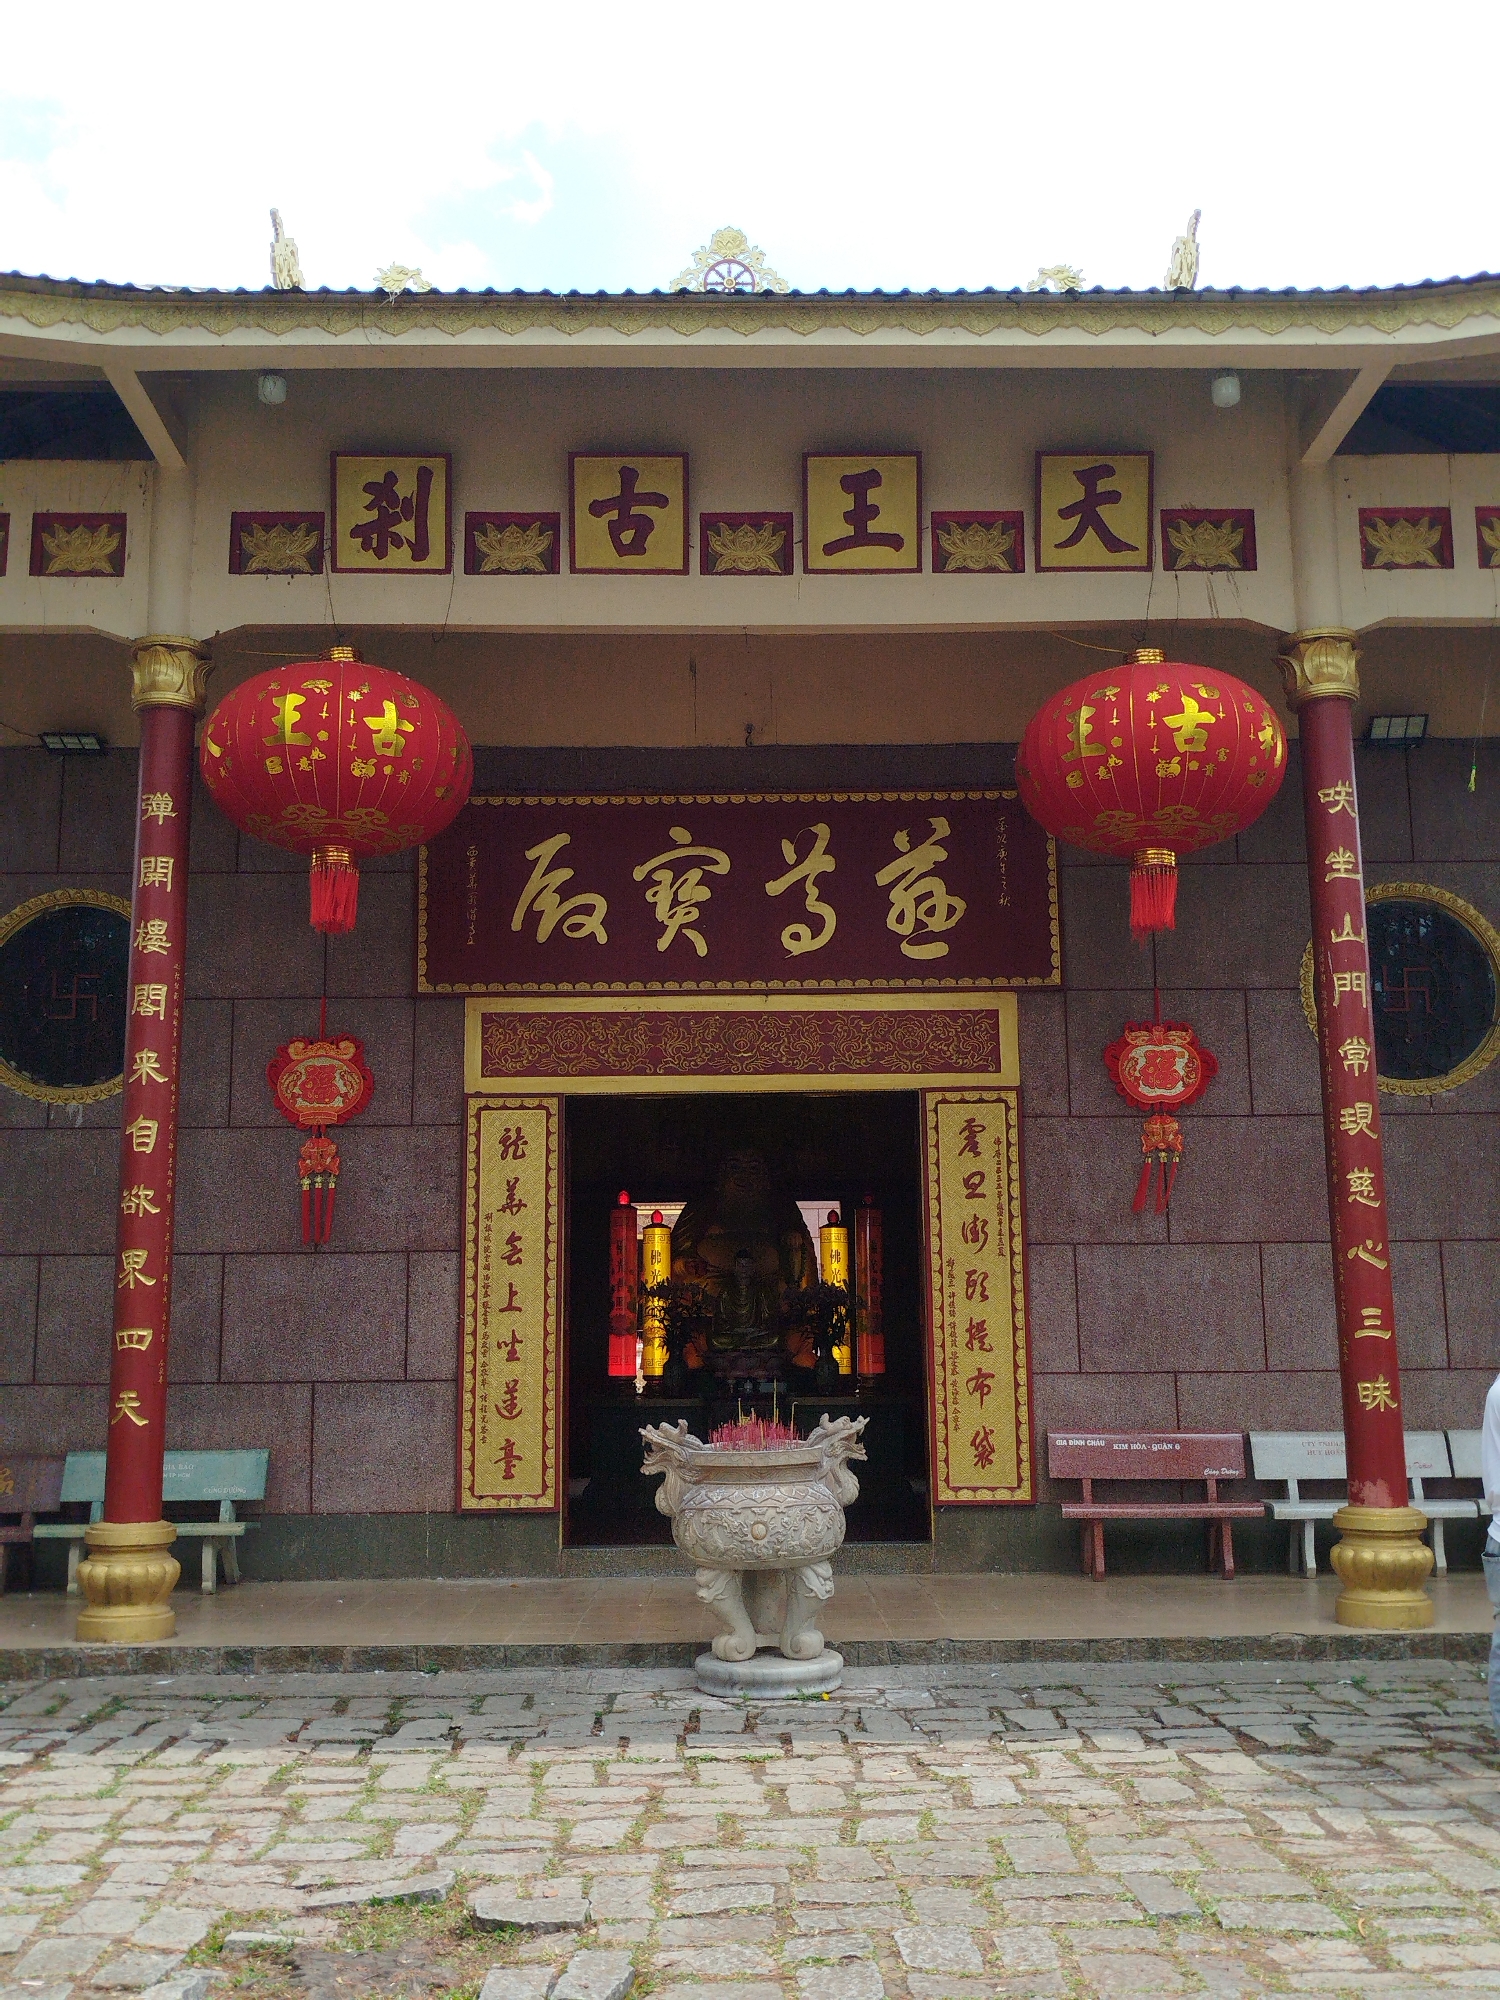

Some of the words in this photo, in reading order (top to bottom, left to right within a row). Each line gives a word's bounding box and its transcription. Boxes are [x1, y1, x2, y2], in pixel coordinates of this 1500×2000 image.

[588, 465, 670, 558] 古
[822, 468, 905, 557] 王
[1053, 463, 1140, 554] 天
[262, 692, 313, 746] 王
[363, 699, 415, 758] 古
[1061, 705, 1108, 763] 王
[1162, 694, 1216, 753] 古
[1113, 1442, 1129, 1451] KIM
